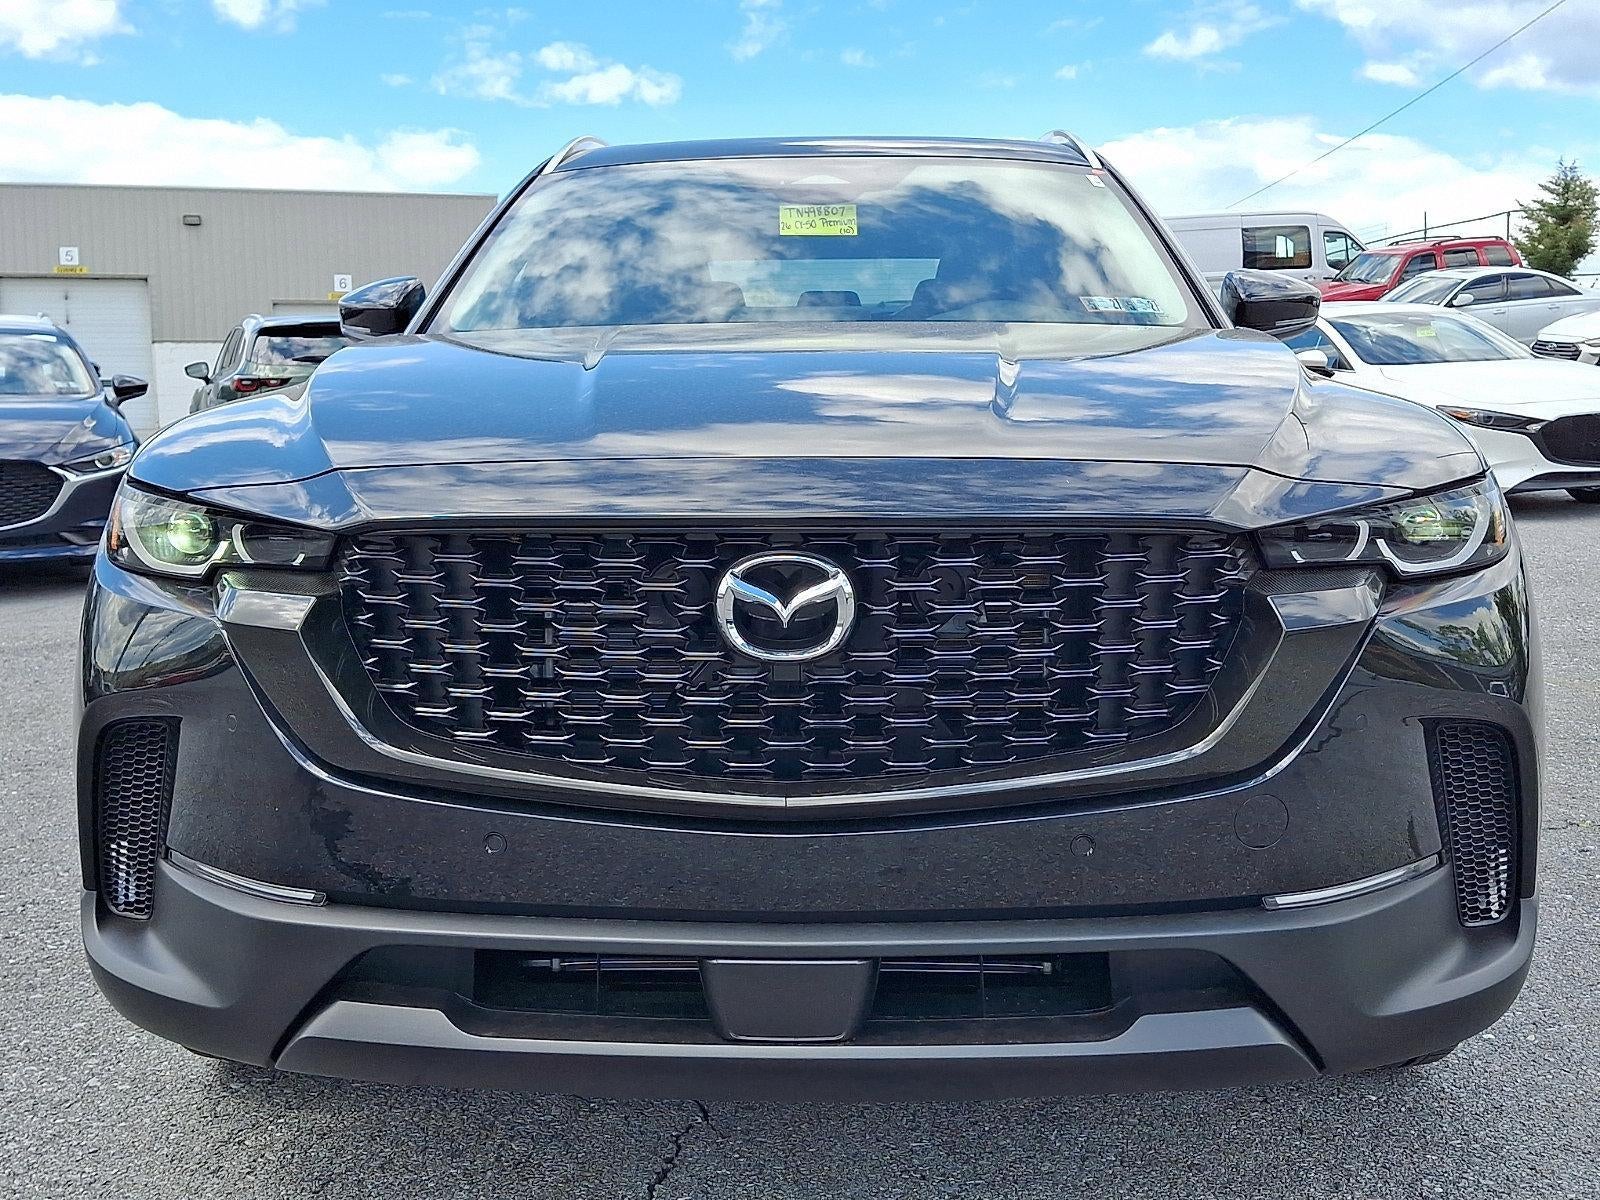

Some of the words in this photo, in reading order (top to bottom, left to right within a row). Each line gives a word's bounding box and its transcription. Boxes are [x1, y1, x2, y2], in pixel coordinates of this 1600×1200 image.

[783, 206, 846, 218] TN498807
[64, 249, 74, 263] 5
[339, 277, 347, 289] 6
